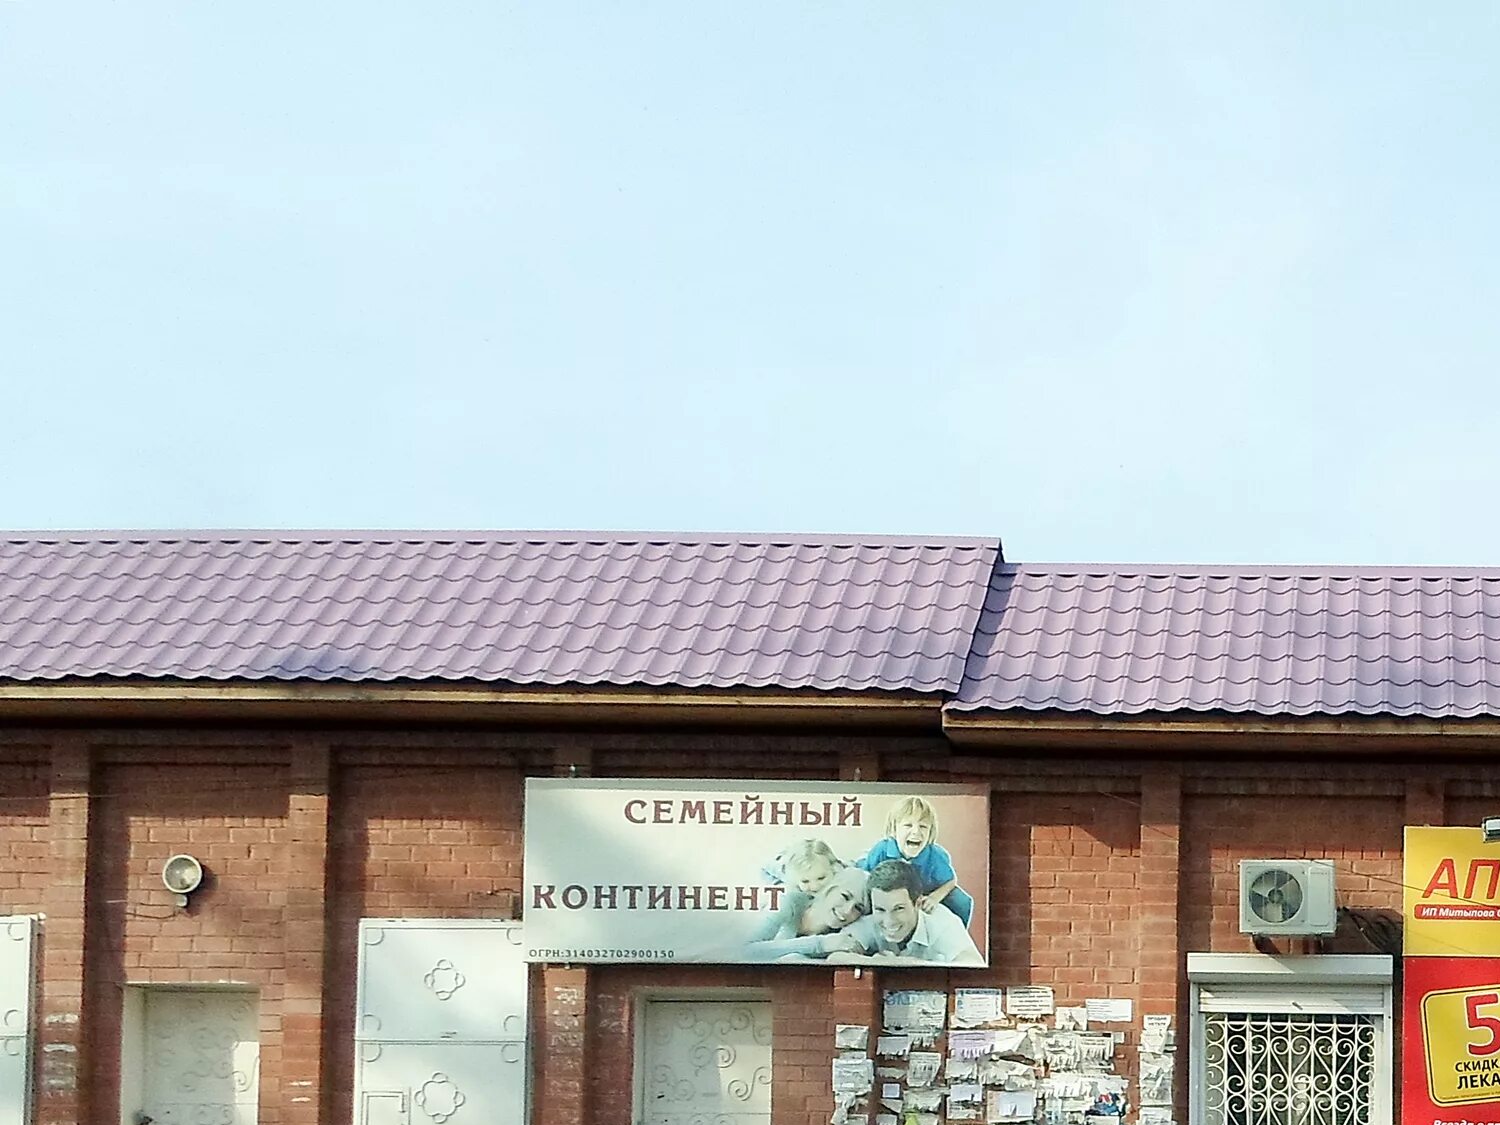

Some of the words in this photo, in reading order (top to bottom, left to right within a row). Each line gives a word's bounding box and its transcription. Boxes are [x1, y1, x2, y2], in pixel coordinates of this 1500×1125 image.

[624, 794, 862, 827] СЕМЕЙНЫЙ
[532, 884, 786, 912] КОНТИНЕНТ
[1422, 907, 1437, 917] ИП
